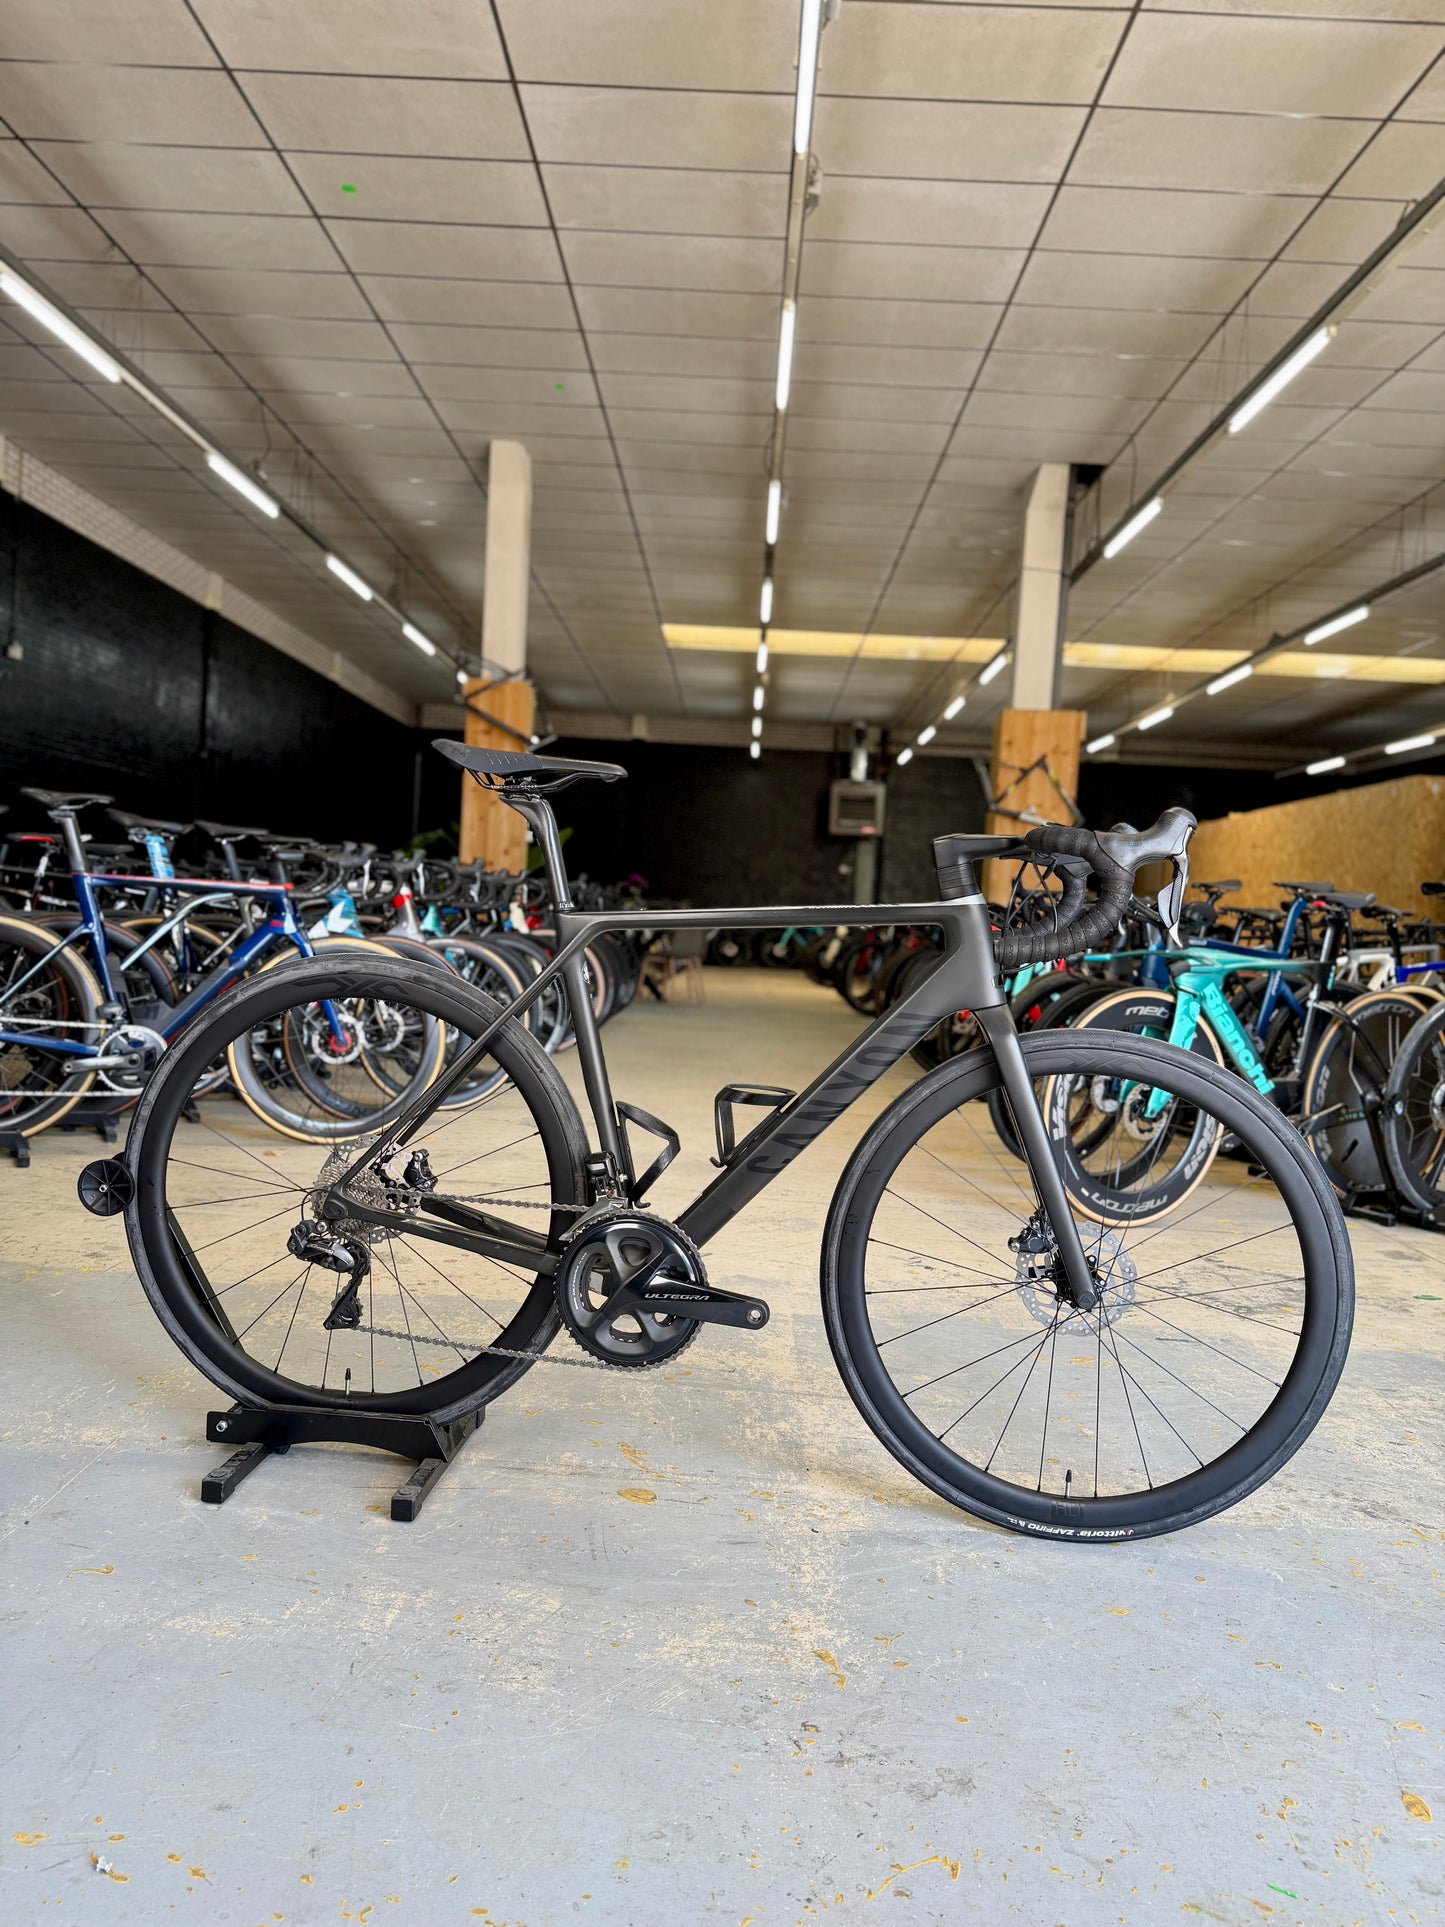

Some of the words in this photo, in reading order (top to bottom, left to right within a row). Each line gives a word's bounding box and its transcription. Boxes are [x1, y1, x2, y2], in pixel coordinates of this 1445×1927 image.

[1125, 1005, 1171, 1019] met
[1203, 982, 1275, 1095] Bianchi
[747, 1012, 943, 1174] CANYON
[1091, 1190, 1168, 1213] metron
[644, 1292, 710, 1301] ULTEGRA
[1080, 1529, 1126, 1538] vittoria
